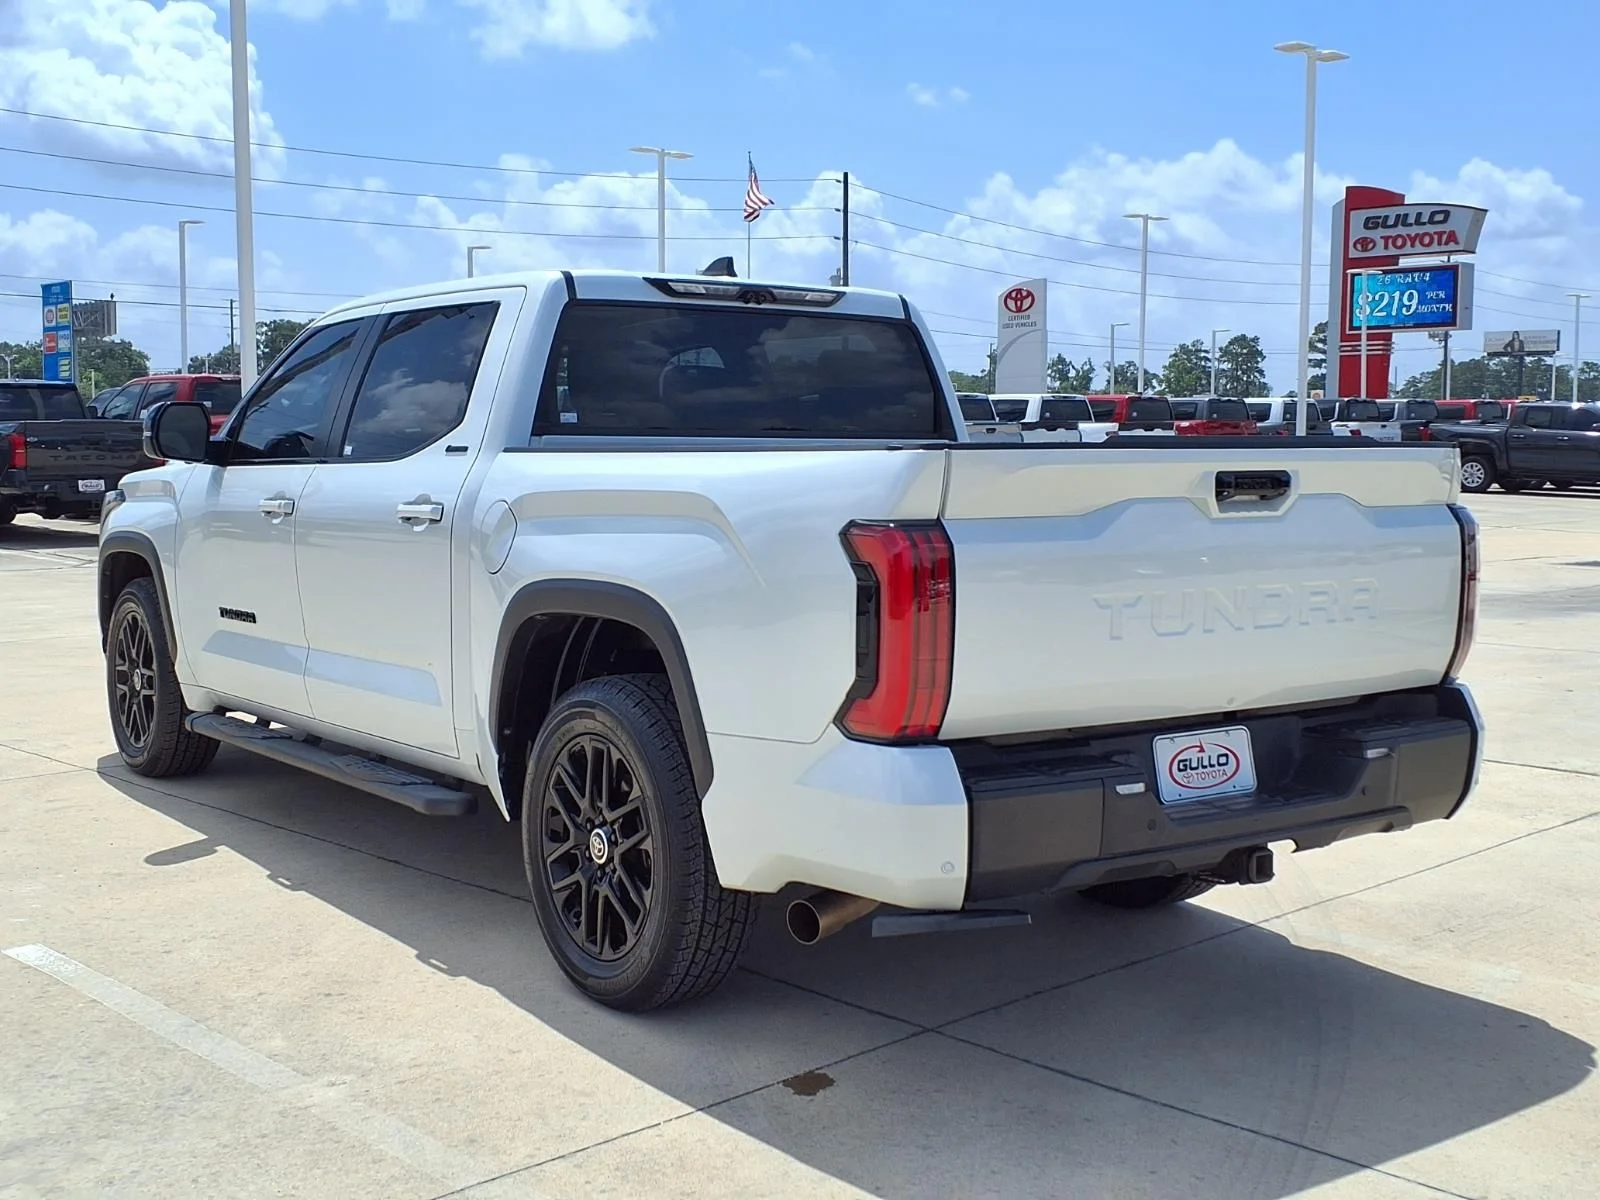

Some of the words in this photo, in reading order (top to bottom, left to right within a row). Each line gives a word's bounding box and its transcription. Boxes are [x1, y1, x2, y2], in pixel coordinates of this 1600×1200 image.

[1363, 209, 1451, 231] GULLO
[1380, 230, 1460, 251] TOYOTA
[1355, 289, 1419, 320] $219
[1425, 290, 1446, 299] PER
[1092, 578, 1380, 641] TUNDRA
[1177, 753, 1230, 773] GULLO
[1195, 768, 1229, 782] TOYOTA
